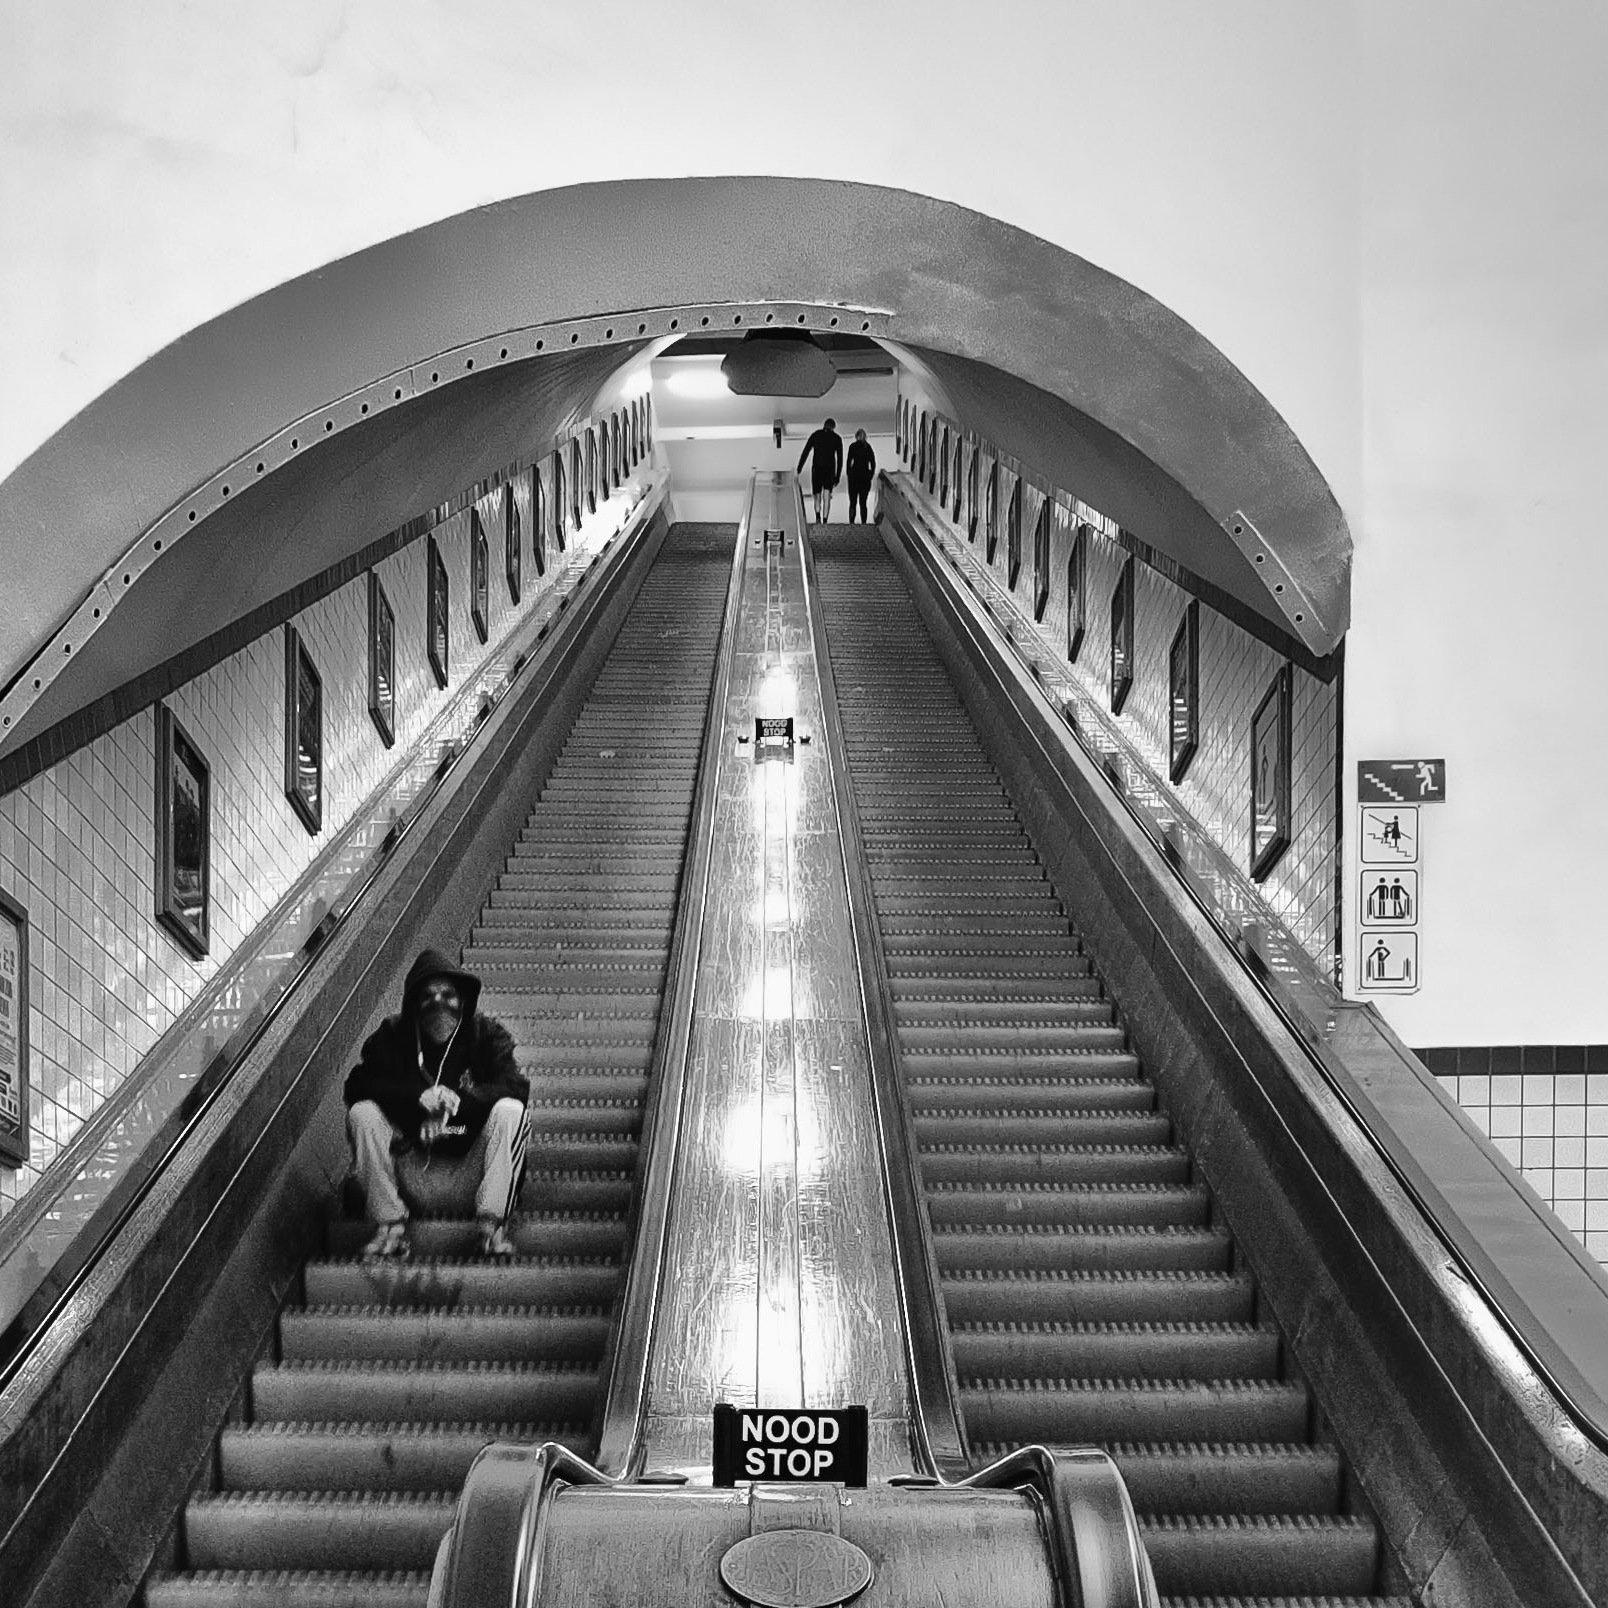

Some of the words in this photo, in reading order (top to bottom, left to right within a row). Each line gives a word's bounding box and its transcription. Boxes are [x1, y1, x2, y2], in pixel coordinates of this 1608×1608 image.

[764, 728, 786, 736] STOP
[741, 1415, 840, 1444] NOOD
[744, 1449, 835, 1478] STOP
